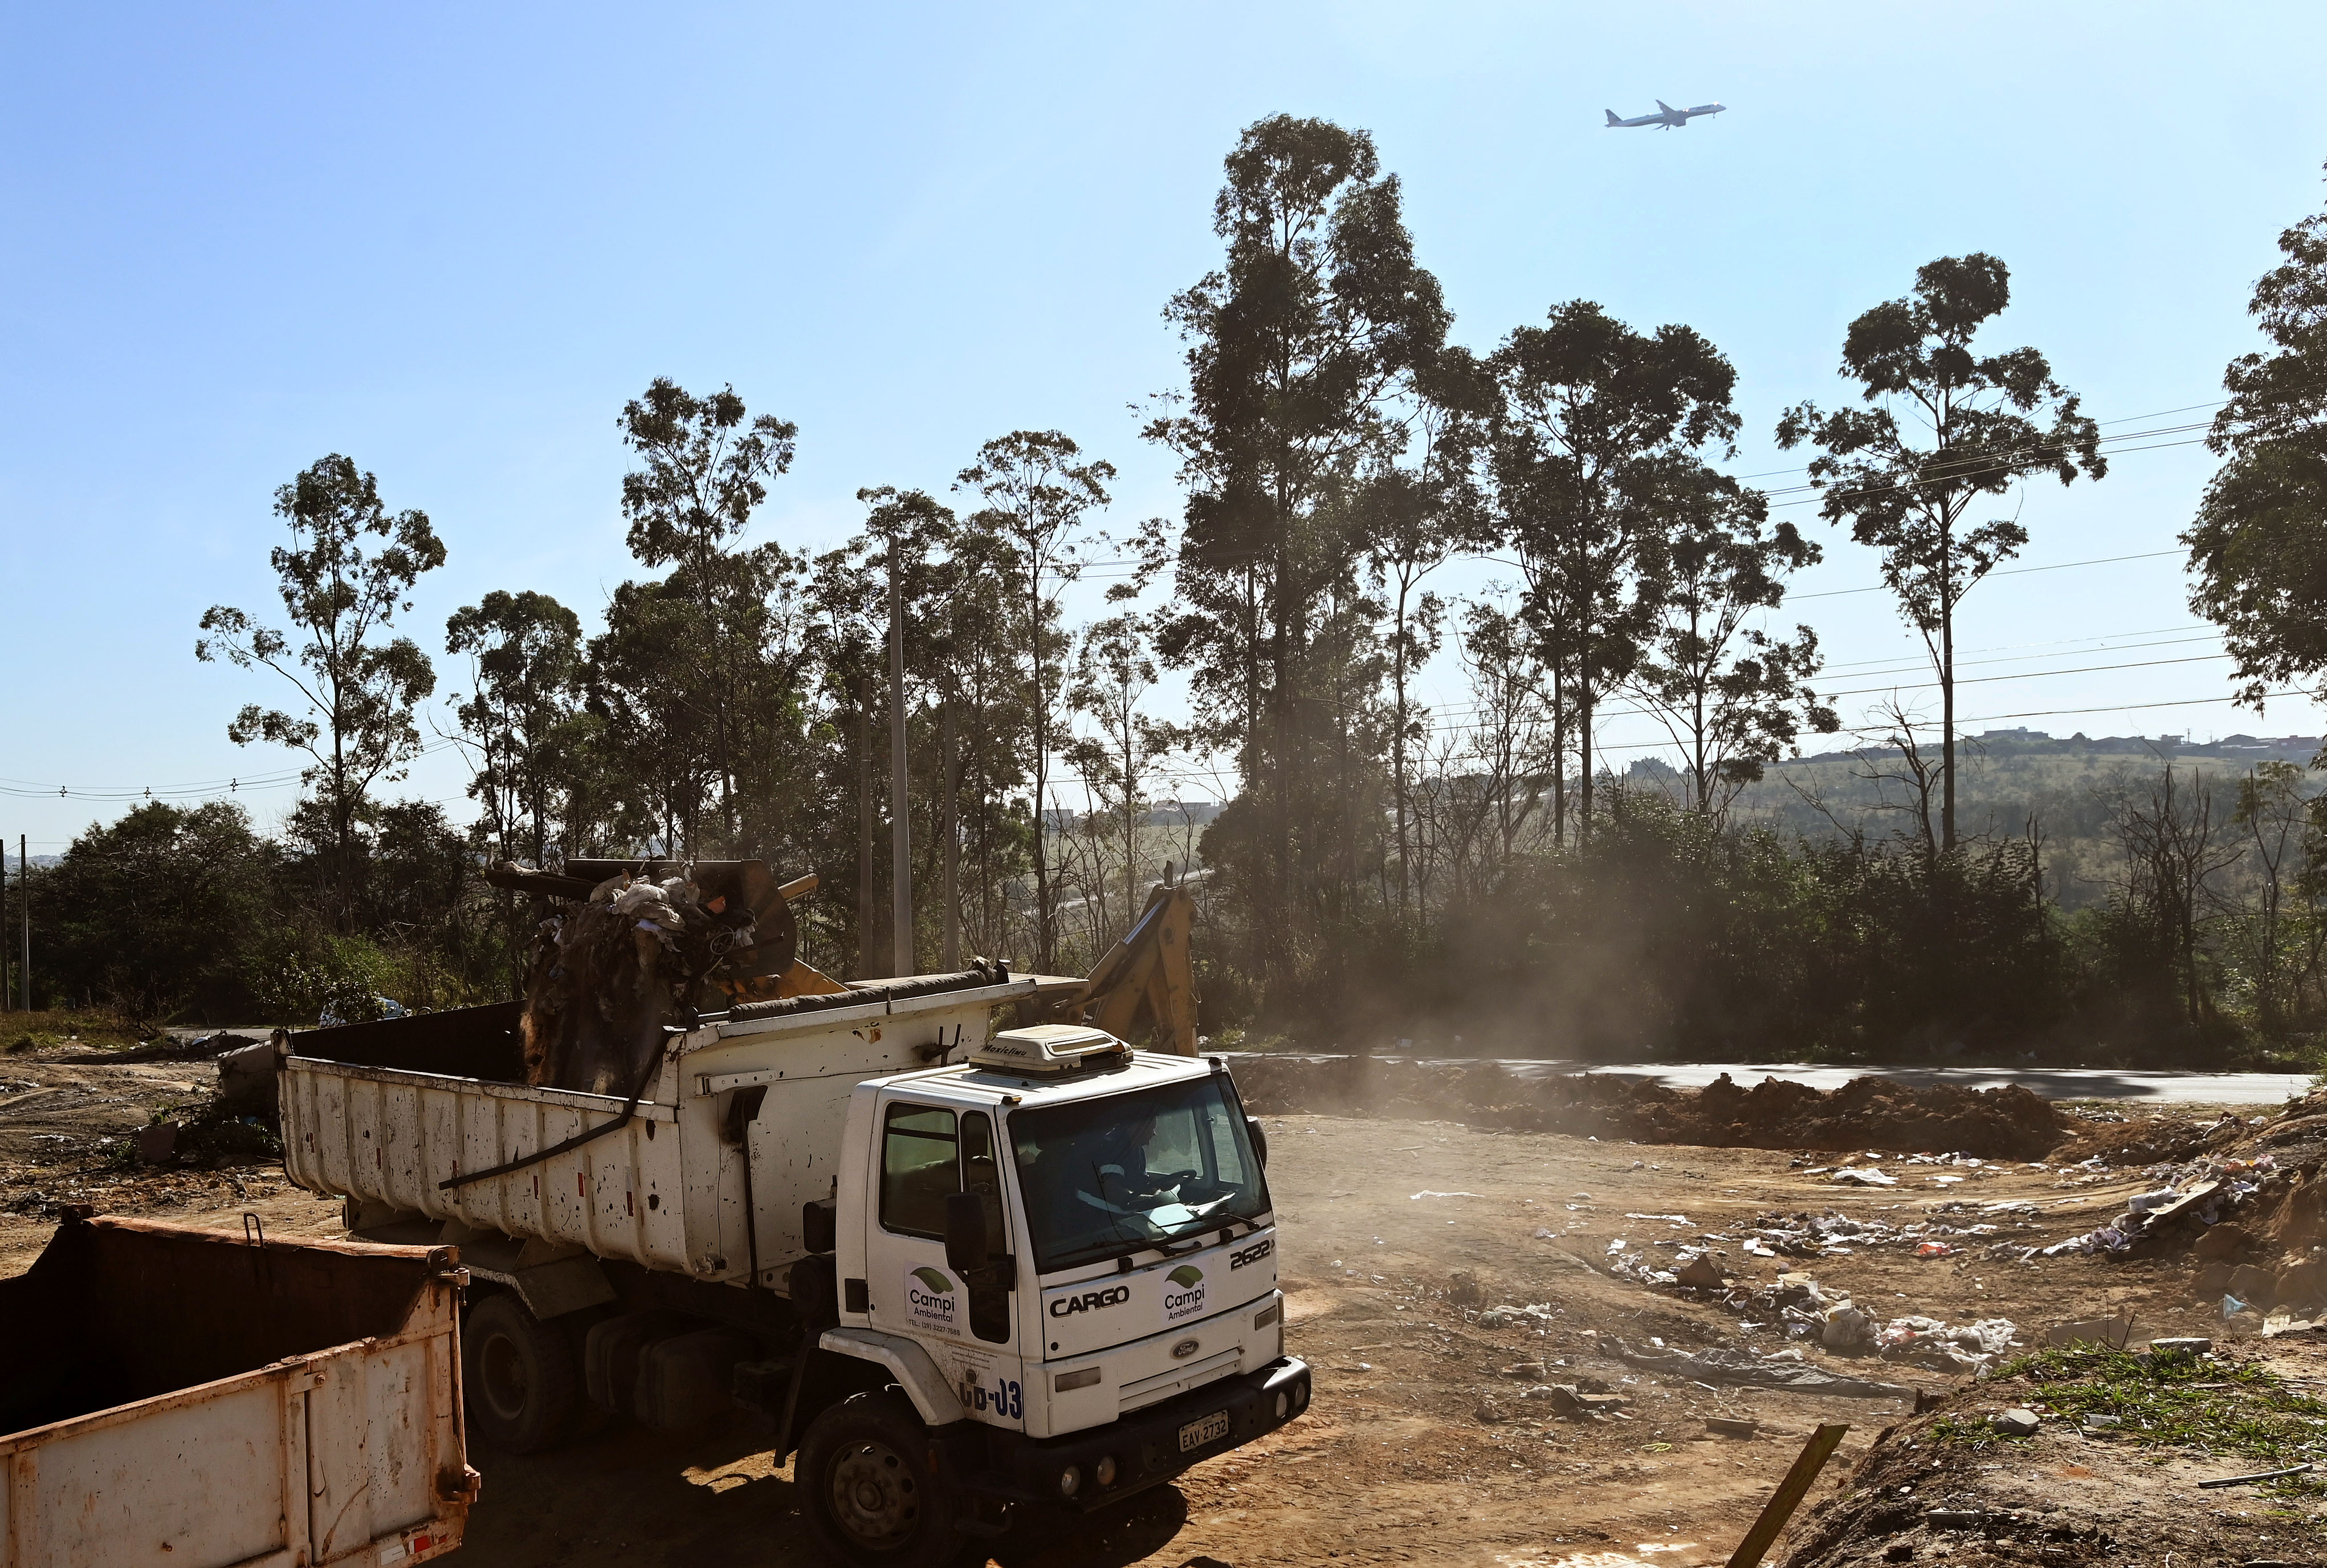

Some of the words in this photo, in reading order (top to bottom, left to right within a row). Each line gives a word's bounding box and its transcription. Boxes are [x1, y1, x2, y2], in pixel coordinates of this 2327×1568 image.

[1230, 1240, 1270, 1272] 2622
[910, 1289, 955, 1313] Campi
[1049, 1285, 1130, 1318] CARGO
[1164, 1284, 1205, 1309] Campi
[914, 1307, 953, 1322] Ambiental
[1168, 1302, 1203, 1321] Ambiental
[922, 1322, 932, 1330] (19)
[1178, 1343, 1195, 1355] Ford
